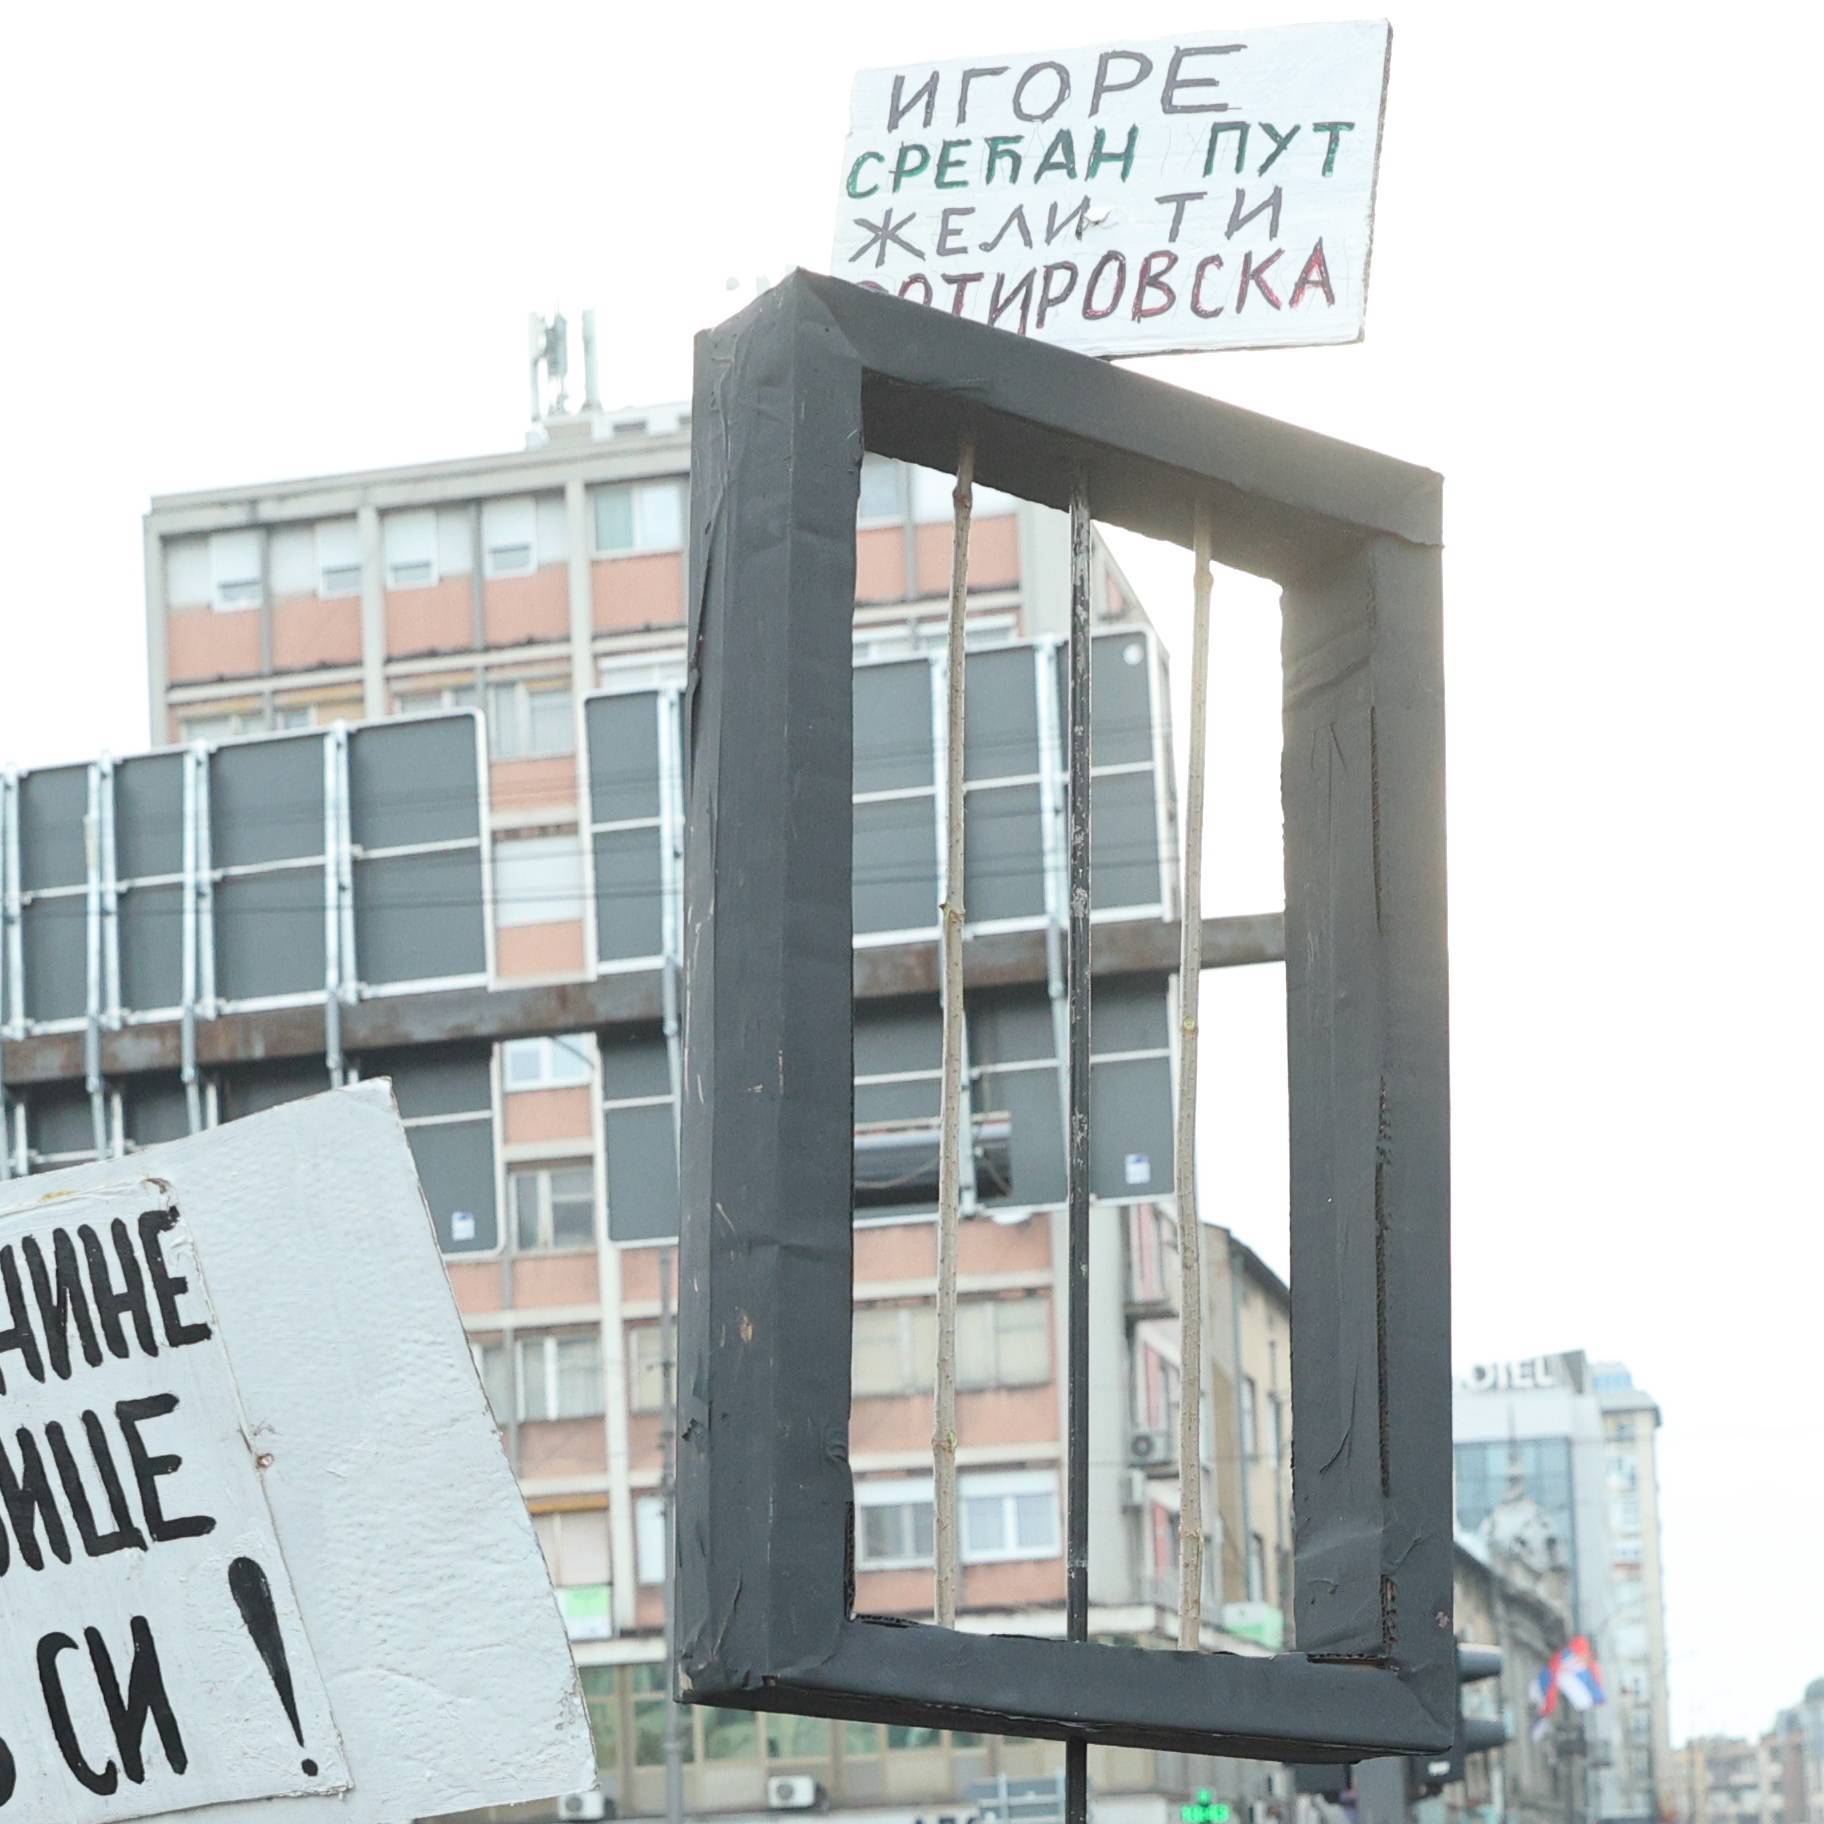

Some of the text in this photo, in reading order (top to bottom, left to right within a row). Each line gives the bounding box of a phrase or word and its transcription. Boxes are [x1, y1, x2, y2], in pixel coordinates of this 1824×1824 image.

[887, 44, 1247, 133] ИГОРЕ
[1203, 121, 1356, 179] ПУТ
[850, 185, 1282, 269] ЖЕЛИ ТИ
[855, 237, 1336, 334] ОТИРОВСКА
[37, 1615, 188, 1798] СИ
